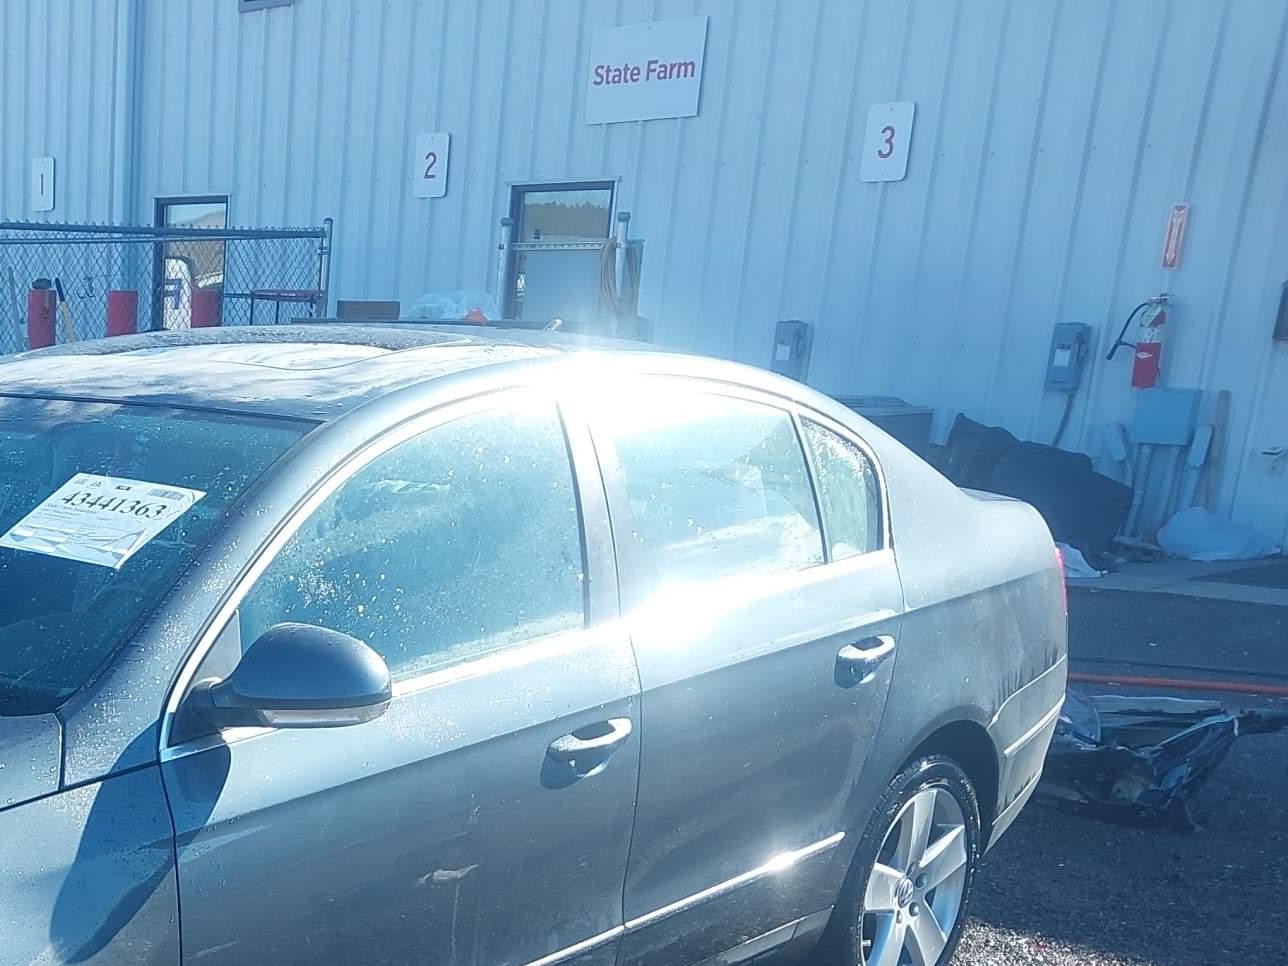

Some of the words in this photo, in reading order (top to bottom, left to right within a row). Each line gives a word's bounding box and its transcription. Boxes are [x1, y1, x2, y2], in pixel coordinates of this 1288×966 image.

[593, 63, 641, 86] State
[645, 59, 696, 81] Farm
[877, 125, 896, 159] 3
[423, 151, 437, 179] 2
[62, 490, 168, 519] 43441363
